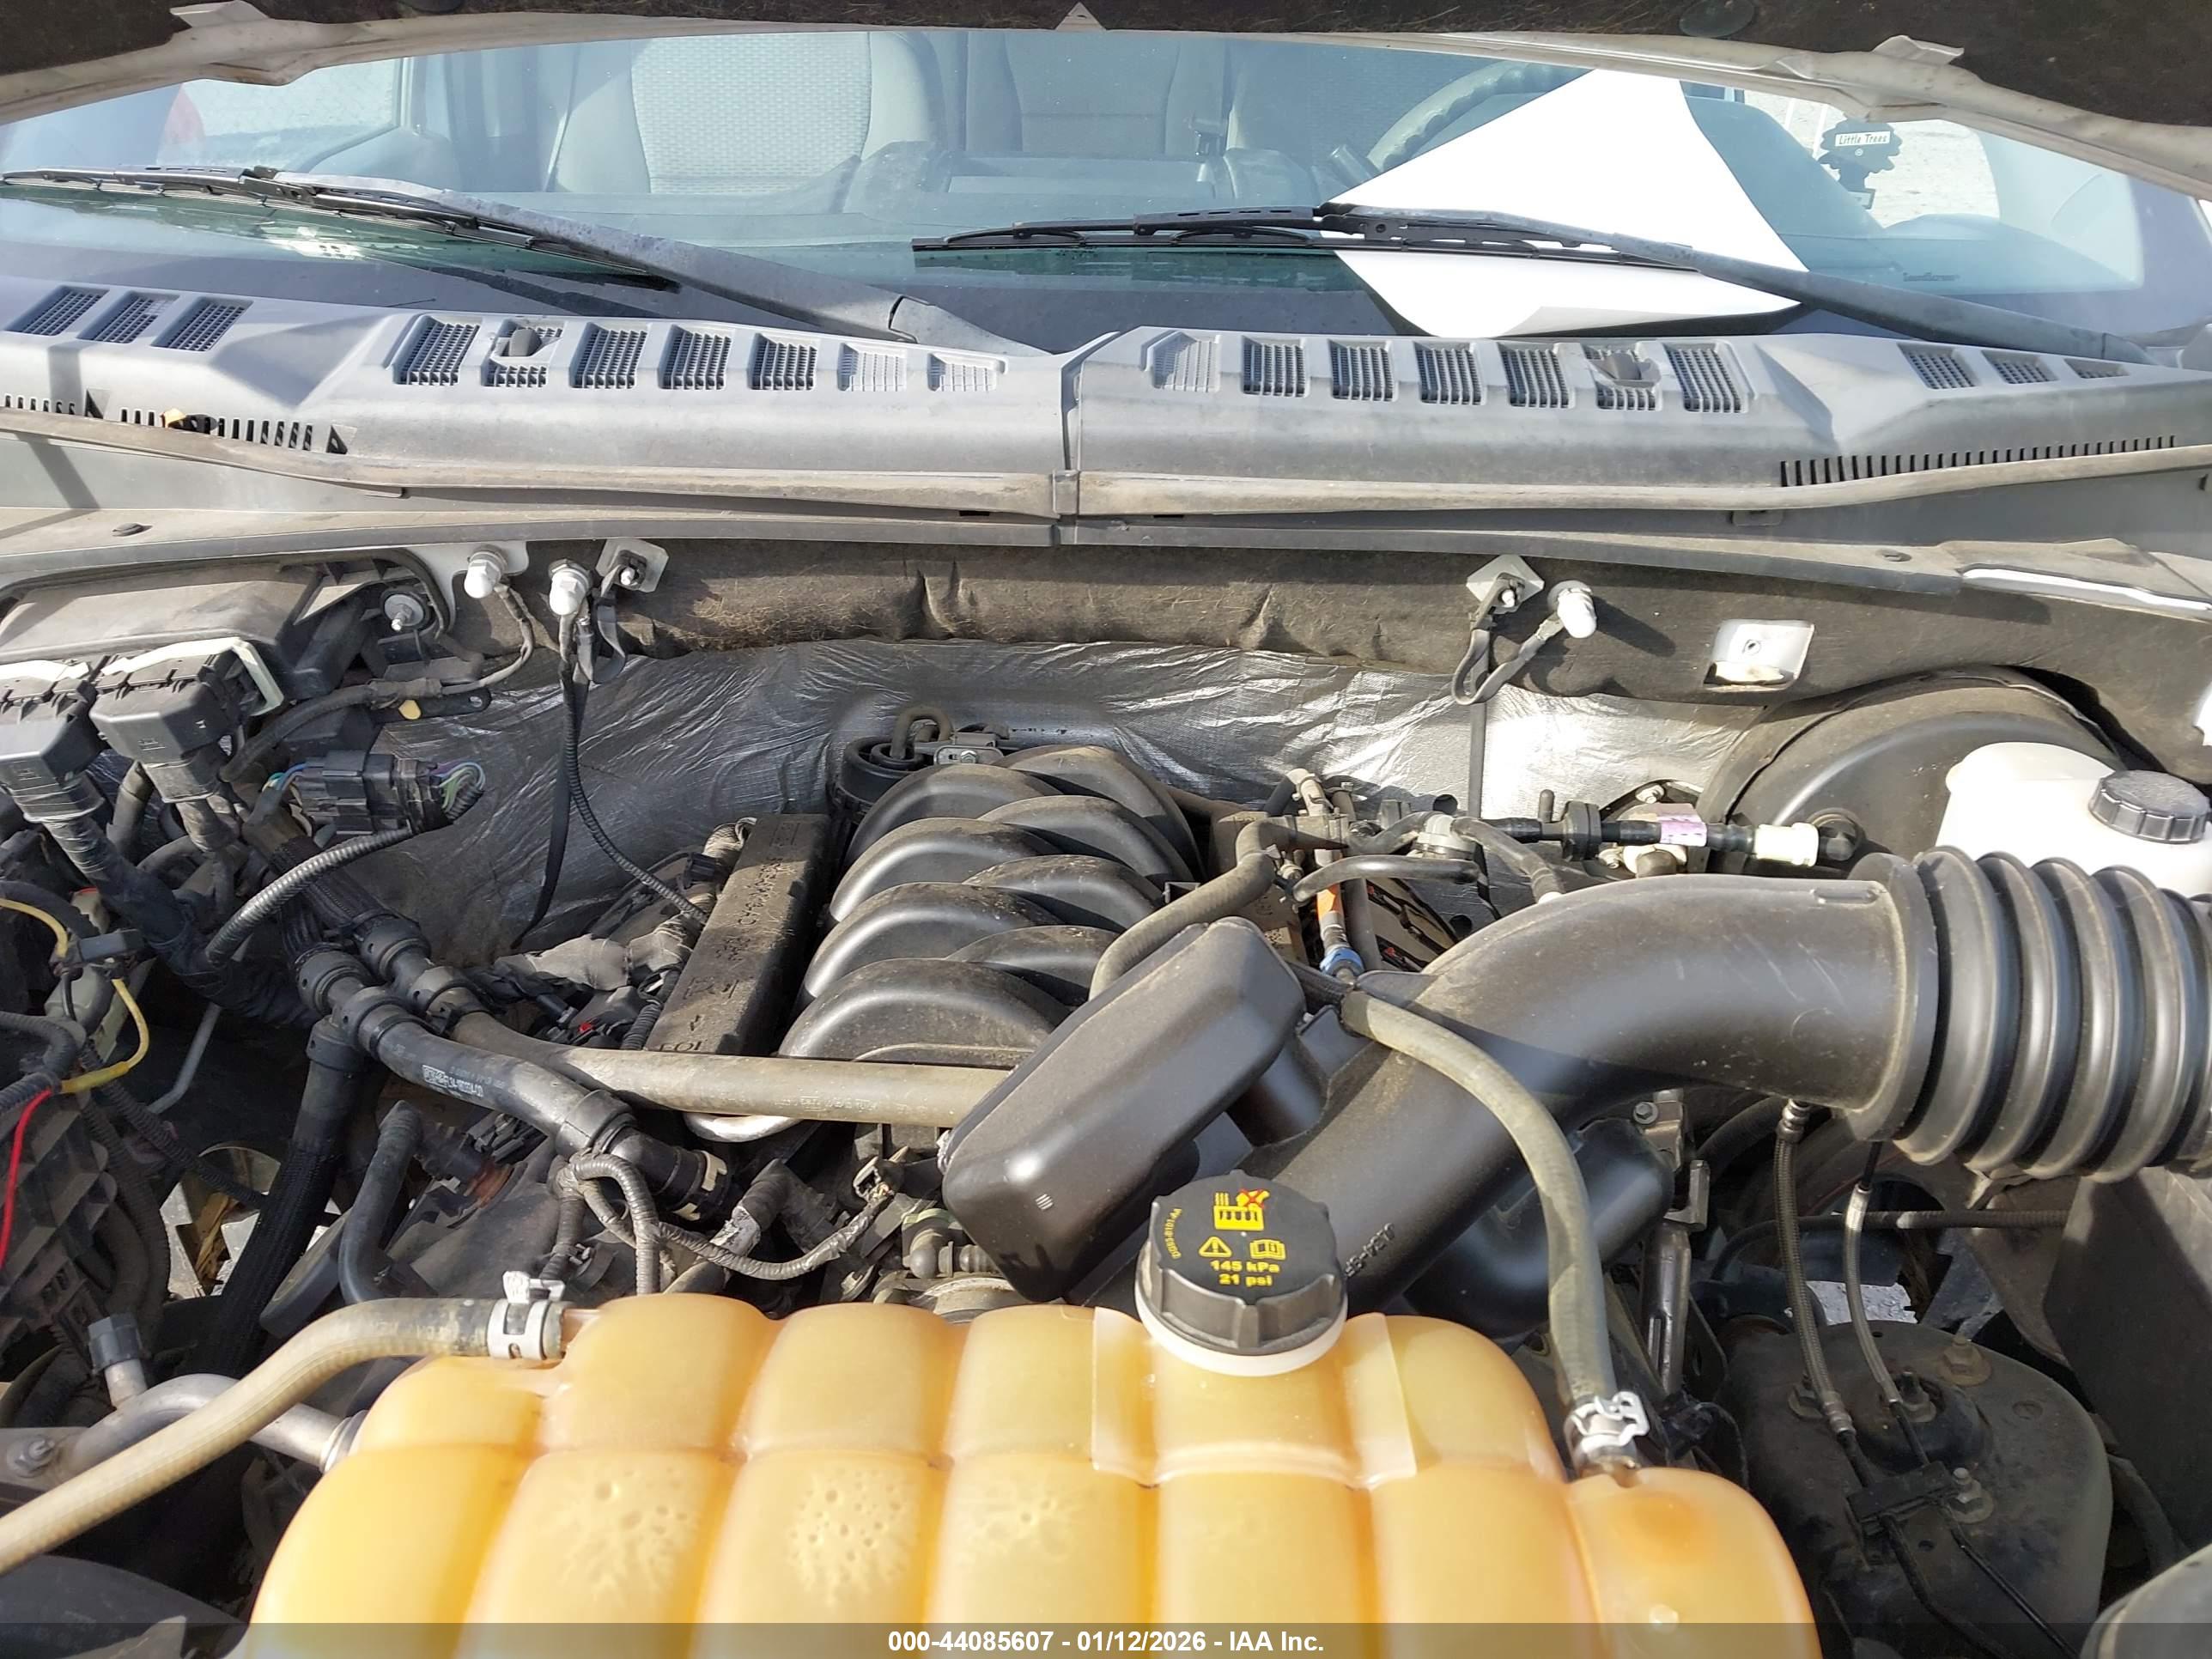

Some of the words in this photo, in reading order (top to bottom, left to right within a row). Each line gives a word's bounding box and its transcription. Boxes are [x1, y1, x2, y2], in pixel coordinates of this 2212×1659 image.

[1838, 134, 1862, 145] Little
[1865, 133, 1887, 143] Trees
[1210, 1260, 1243, 1272] 145
[1246, 1261, 1280, 1273] kPa
[1218, 1273, 1241, 1285] 21
[1245, 1275, 1273, 1287] psi
